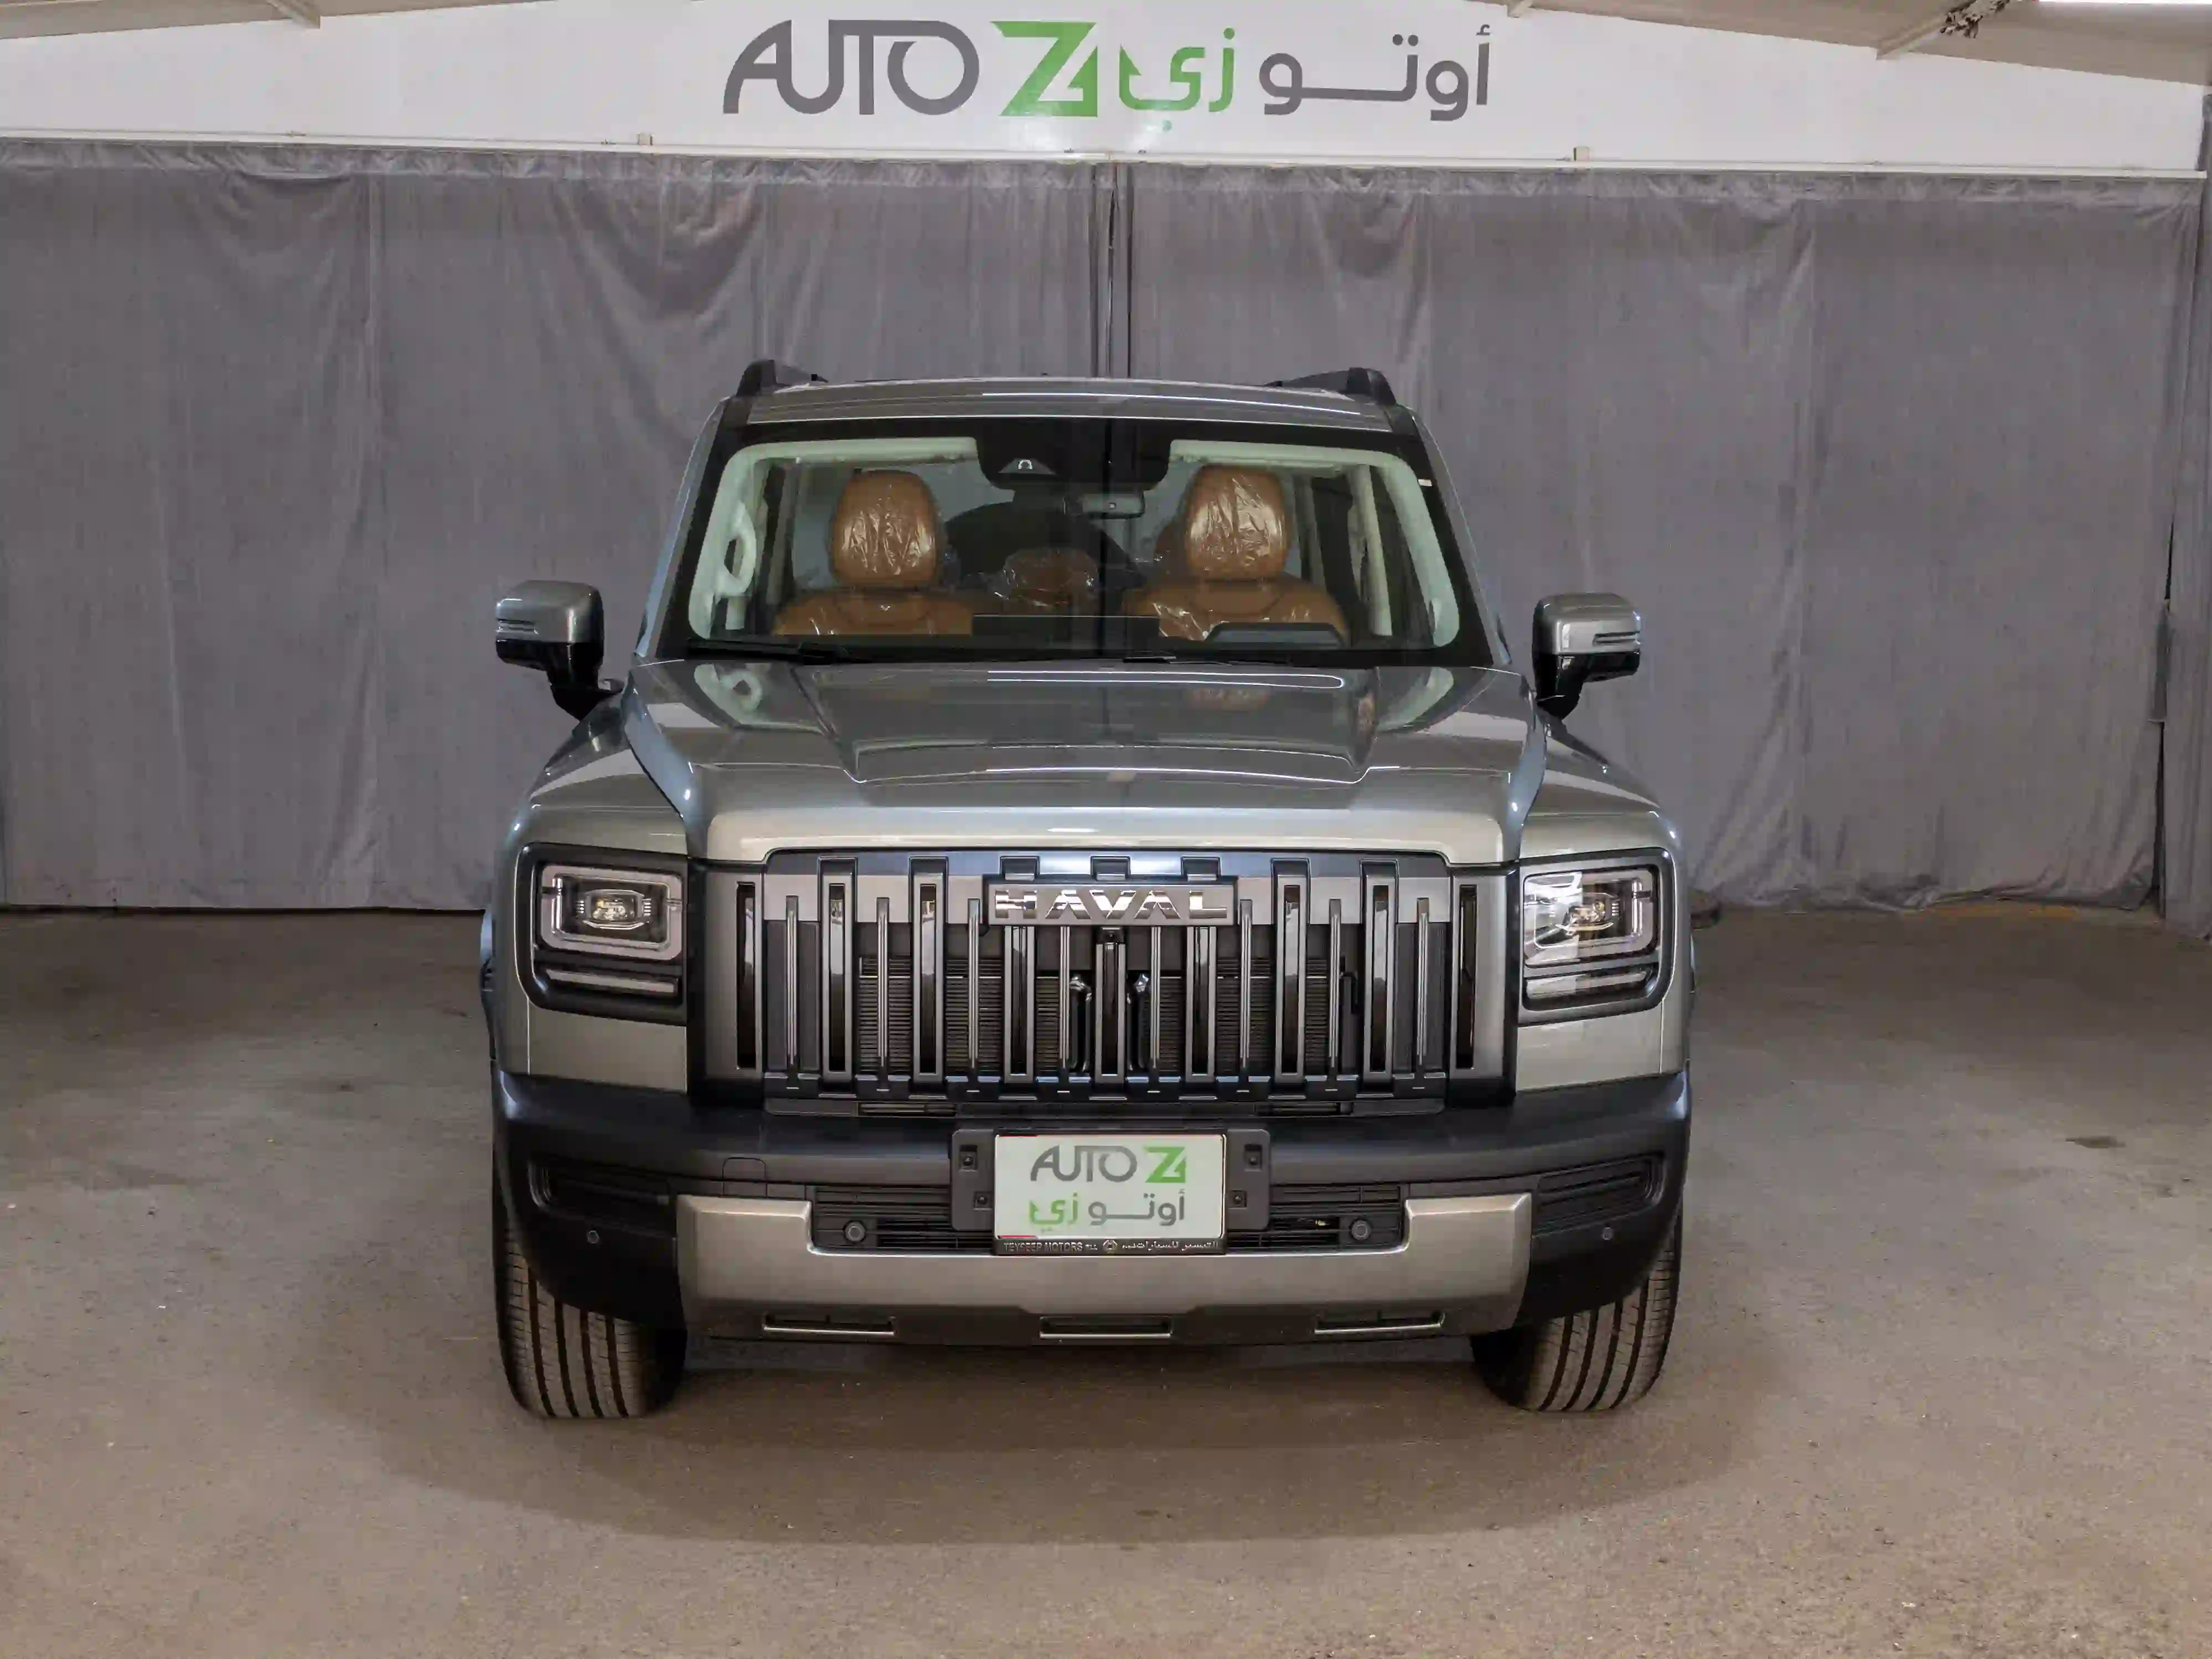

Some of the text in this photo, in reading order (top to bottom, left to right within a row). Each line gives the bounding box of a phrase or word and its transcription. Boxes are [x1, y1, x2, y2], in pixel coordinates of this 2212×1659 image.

[723, 19, 980, 115] AUTO
[995, 890, 1228, 919] HAVAL
[1030, 1145, 1138, 1183] AUTO
[1044, 1242, 1083, 1252] MOTORS
